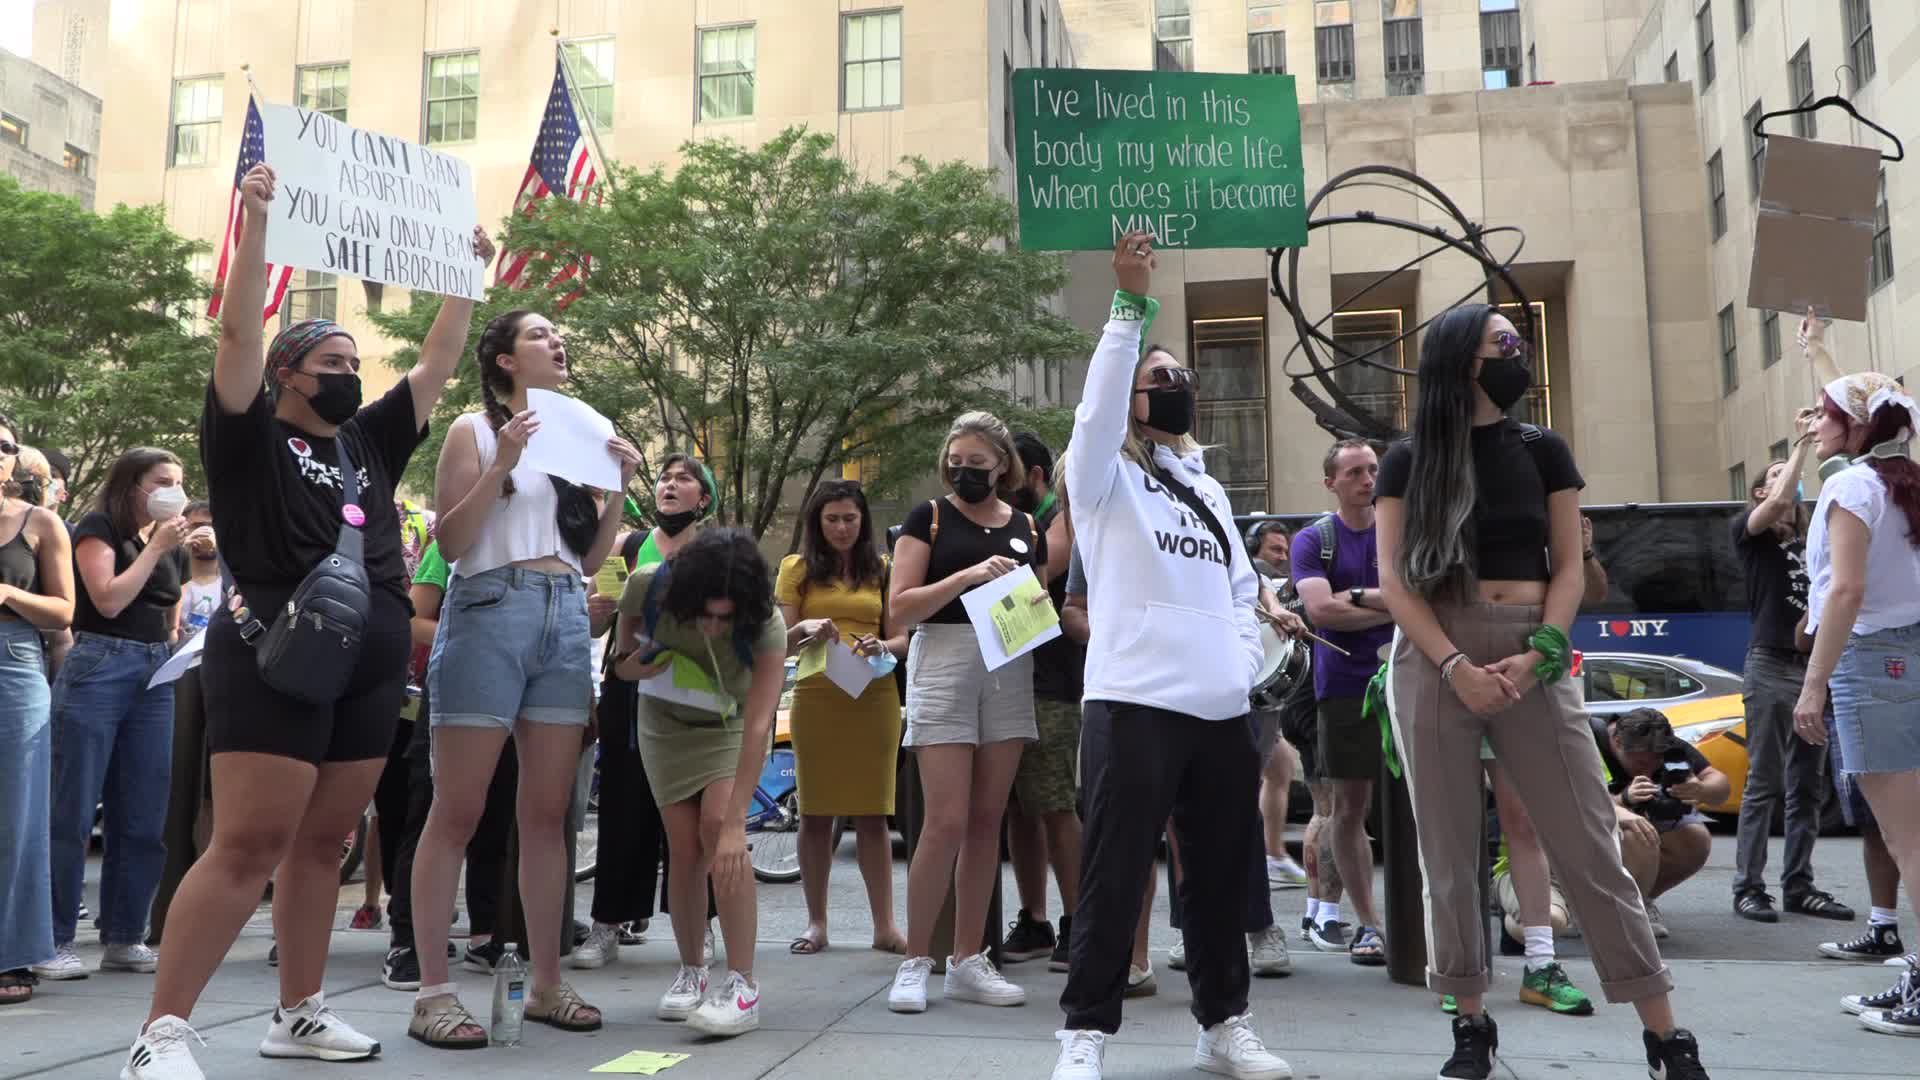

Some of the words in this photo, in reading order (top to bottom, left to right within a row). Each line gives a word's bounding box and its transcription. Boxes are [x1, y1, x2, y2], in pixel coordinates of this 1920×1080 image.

[1034, 79, 1081, 118] I've
[1095, 79, 1156, 119] lived
[1166, 91, 1187, 121] in
[1200, 89, 1250, 126] this
[297, 108, 338, 154] YOU
[420, 148, 461, 188] BAN
[1033, 130, 1103, 173] body
[1118, 141, 1154, 173] my
[1166, 133, 1233, 167] whole
[1243, 135, 1288, 169] life.
[339, 160, 442, 214] ABORTION
[1028, 174, 1099, 210] When
[1109, 175, 1171, 209] does
[1184, 177, 1200, 210] it
[1209, 178, 1297, 210] become
[284, 184, 329, 226] YOU
[339, 200, 380, 239] CAN
[390, 215, 436, 252] ONLY
[442, 227, 478, 262] BAN
[322, 232, 377, 280] SAFE
[384, 247, 473, 298] ABORTION
[1174, 507, 1206, 531] TH
[1154, 530, 1228, 566] WORL
[1598, 620, 1610, 637] I
[1629, 619, 1668, 637] NY
